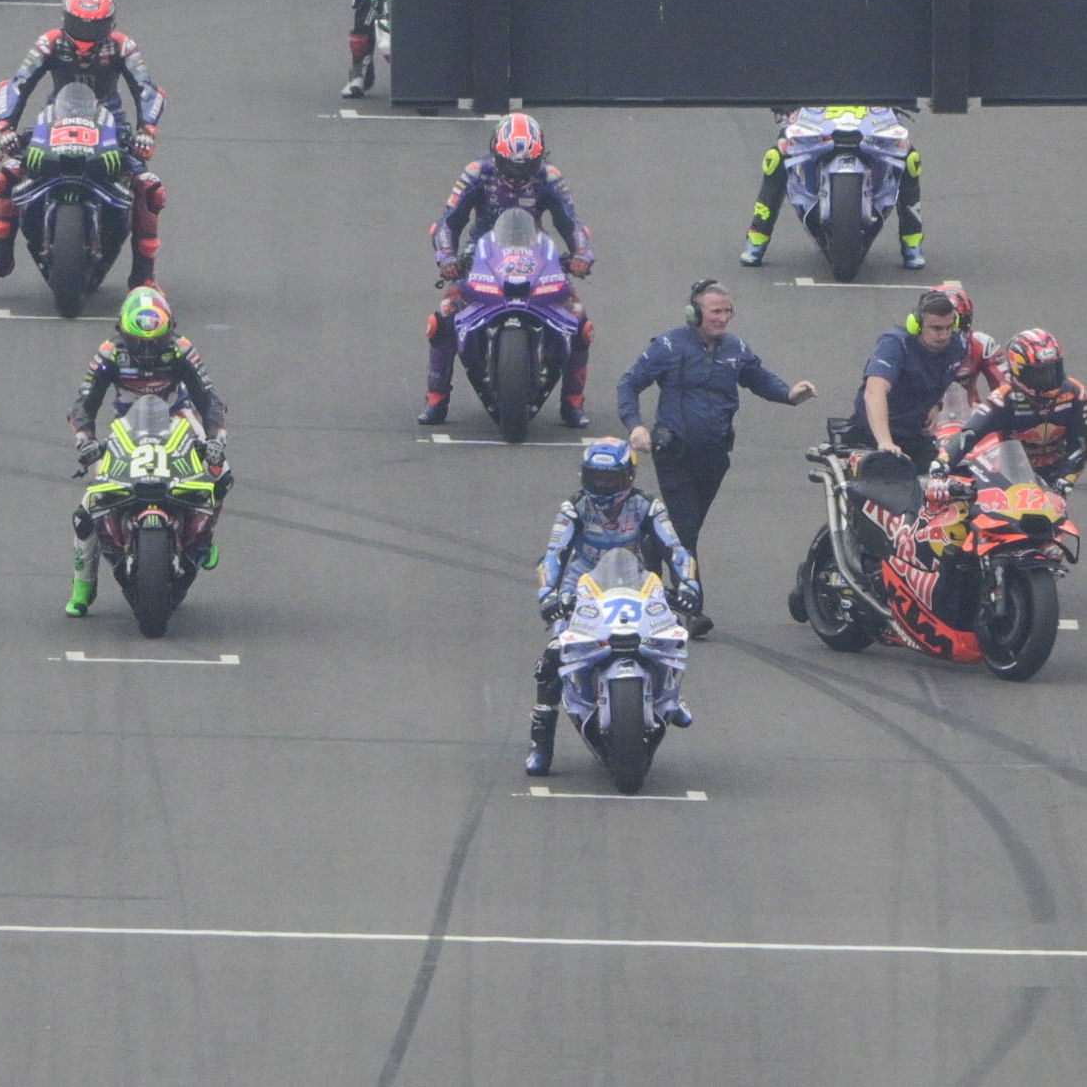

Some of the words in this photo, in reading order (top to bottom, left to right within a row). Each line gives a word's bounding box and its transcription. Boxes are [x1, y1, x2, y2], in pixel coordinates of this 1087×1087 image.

[62, 117, 95, 128] ENEOS
[50, 126, 99, 146] 20
[468, 273, 495, 283] prima
[129, 444, 171, 478] 21
[1015, 487, 1046, 511] 12
[602, 598, 642, 625] 73
